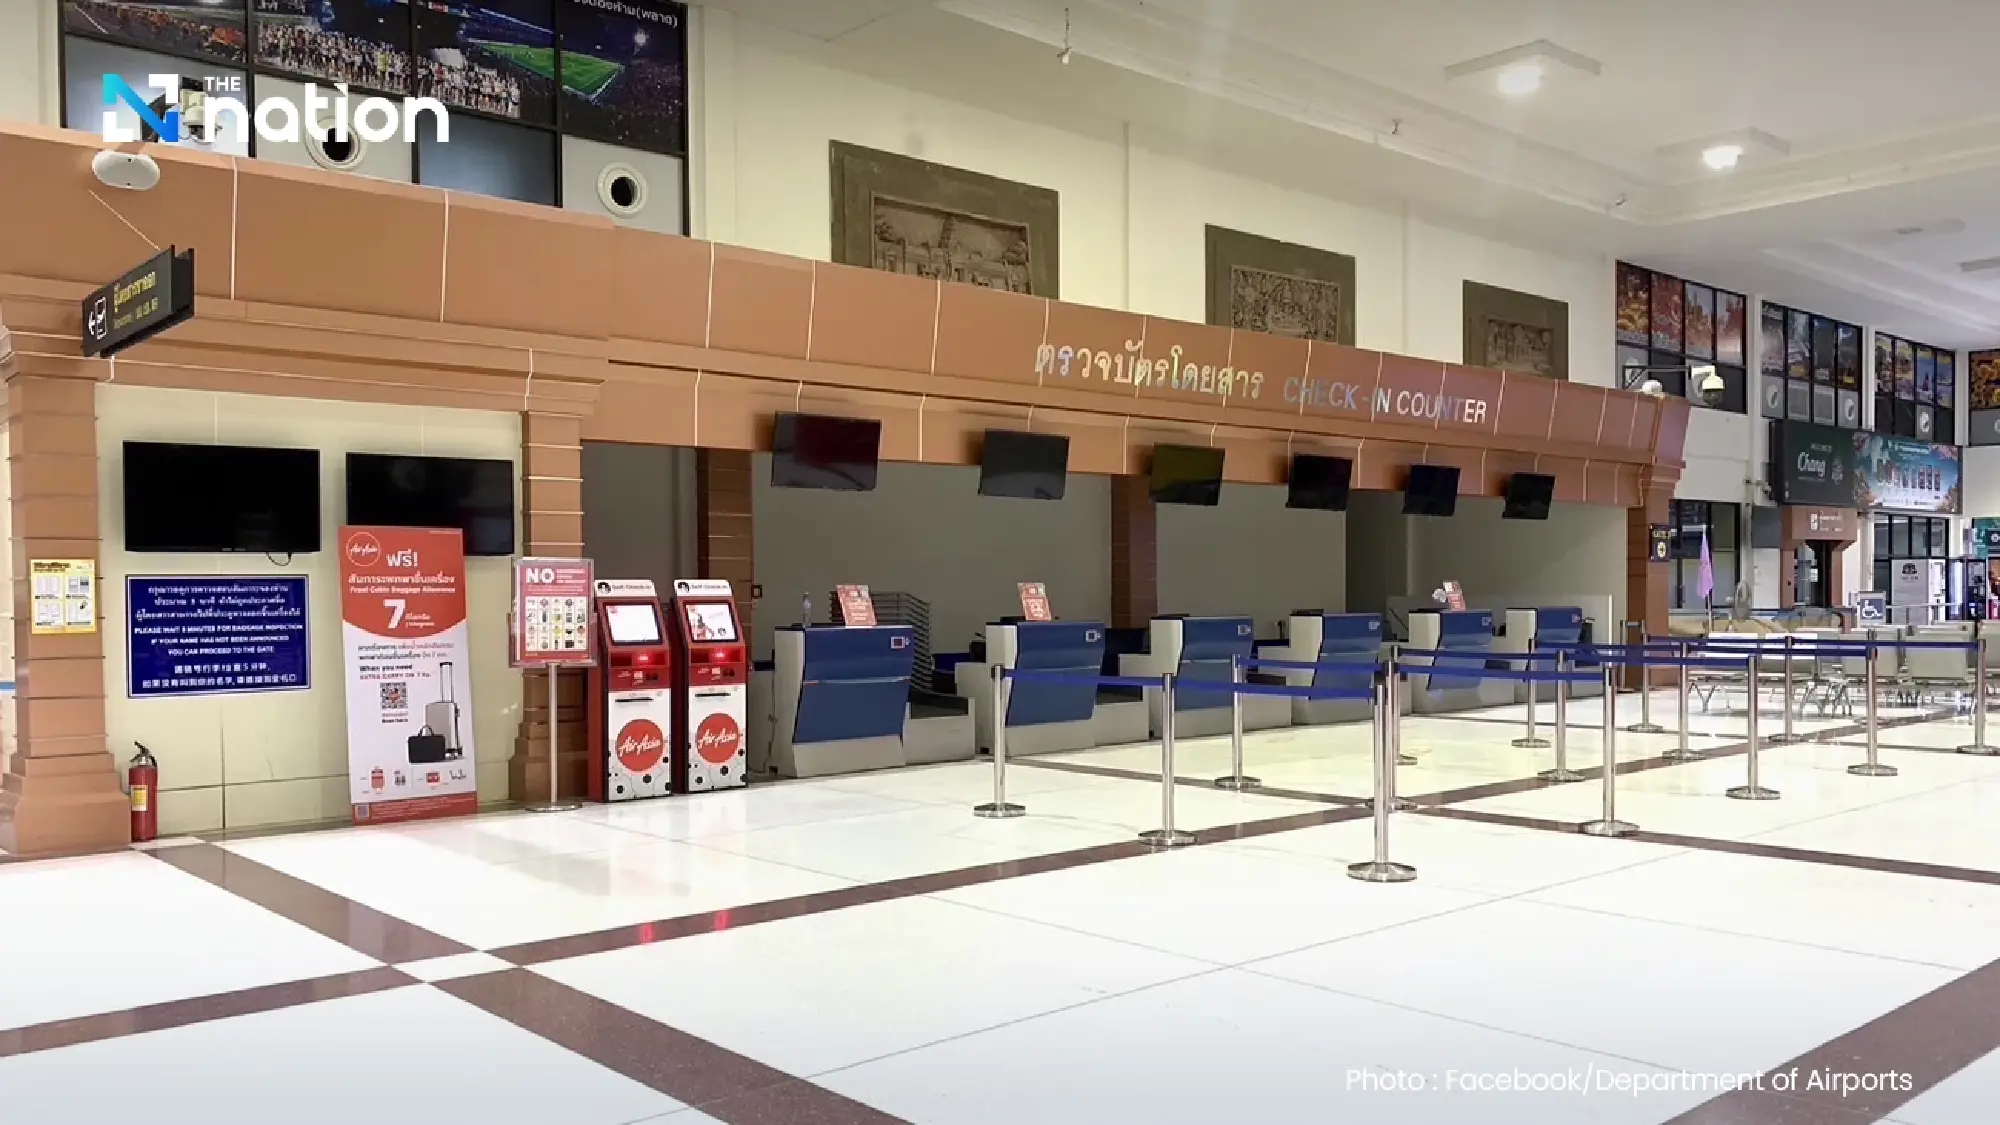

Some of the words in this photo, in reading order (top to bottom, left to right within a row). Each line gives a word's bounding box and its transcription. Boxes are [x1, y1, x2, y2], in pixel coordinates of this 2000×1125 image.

[1035, 339, 1264, 400] ตรวจบัตรโดยสาร
[1397, 390, 1487, 424] COUNTER
[386, 549, 418, 567] ฟรี!
[526, 568, 555, 584] NO
[383, 599, 405, 629] 7
[618, 733, 661, 757] AirAsia
[698, 727, 737, 749] AirAsia
